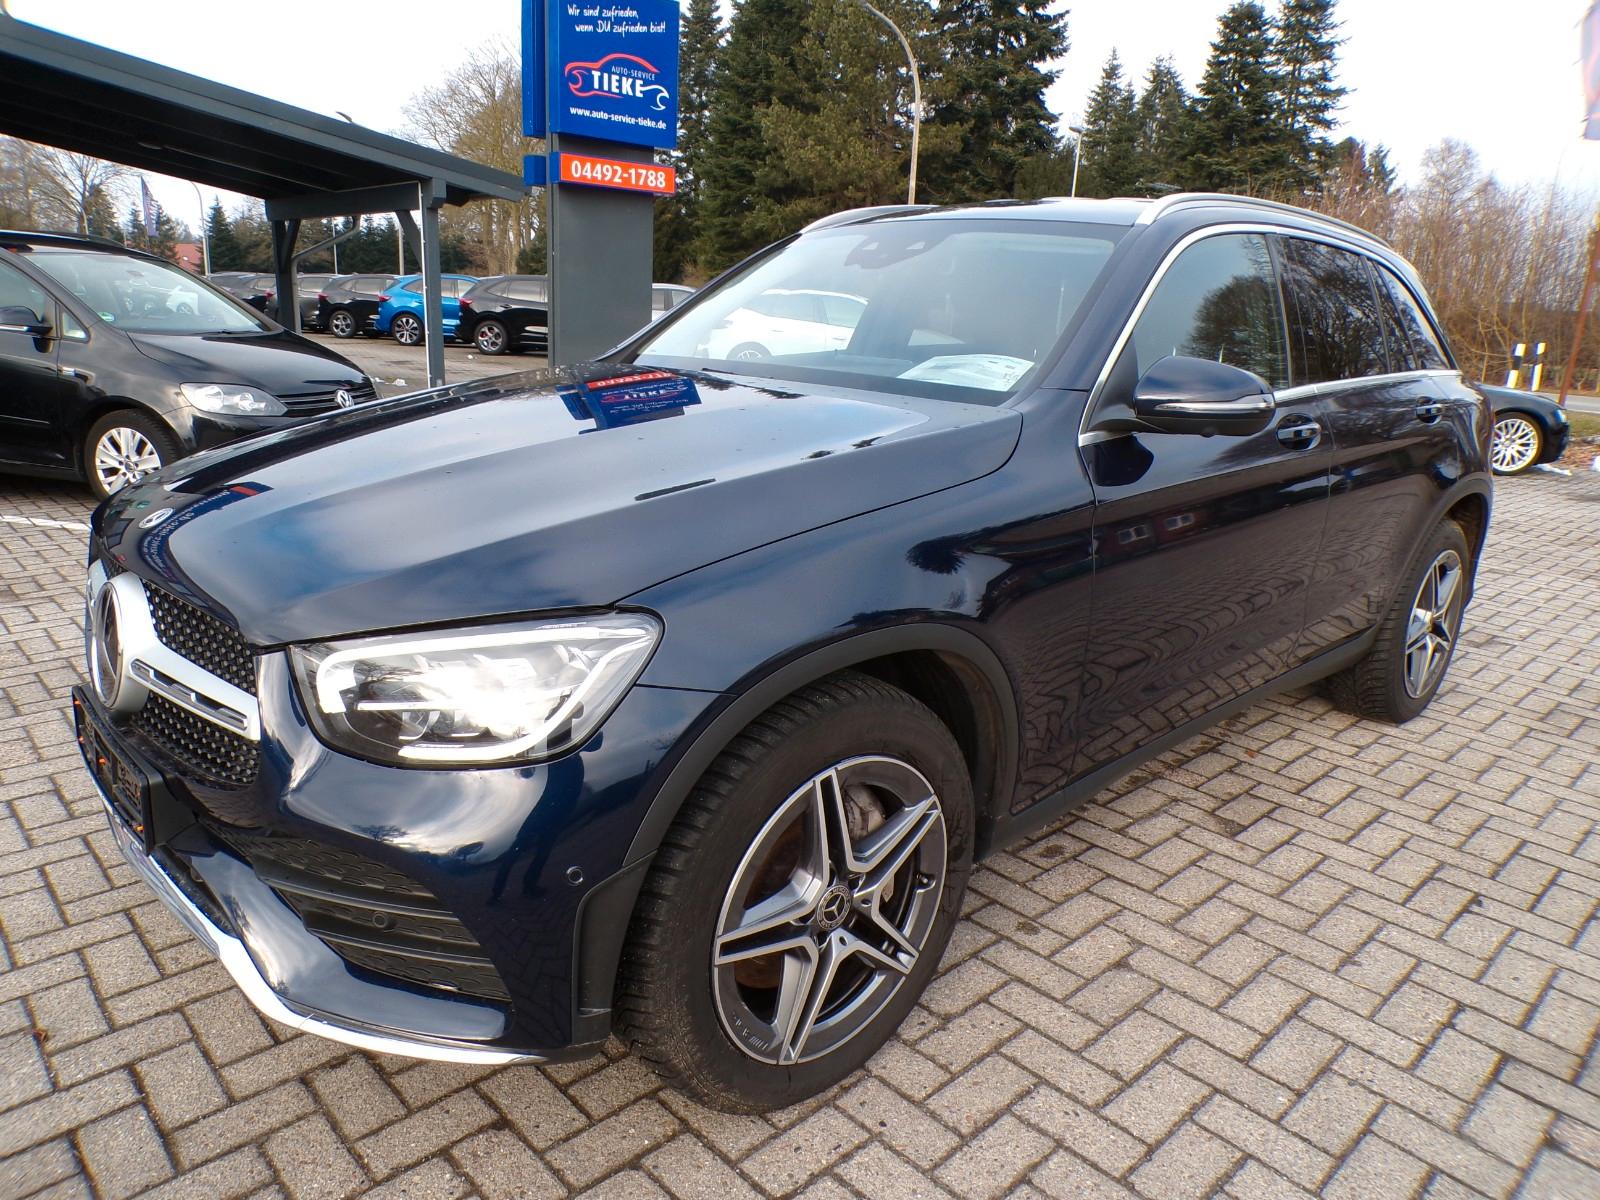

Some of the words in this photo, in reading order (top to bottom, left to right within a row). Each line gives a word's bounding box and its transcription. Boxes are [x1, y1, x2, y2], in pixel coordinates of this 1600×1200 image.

[567, 4, 579, 17] Wir
[583, 5, 599, 17] sind
[575, 24, 593, 33] wenn
[596, 20, 611, 33] DU
[613, 21, 648, 38] zufrieden
[611, 65, 655, 81] AUTO-SERVICE
[591, 70, 644, 98] TIEKE
[569, 106, 667, 130] www.auto-service-tieke.de
[571, 160, 666, 188] 04492-1788
